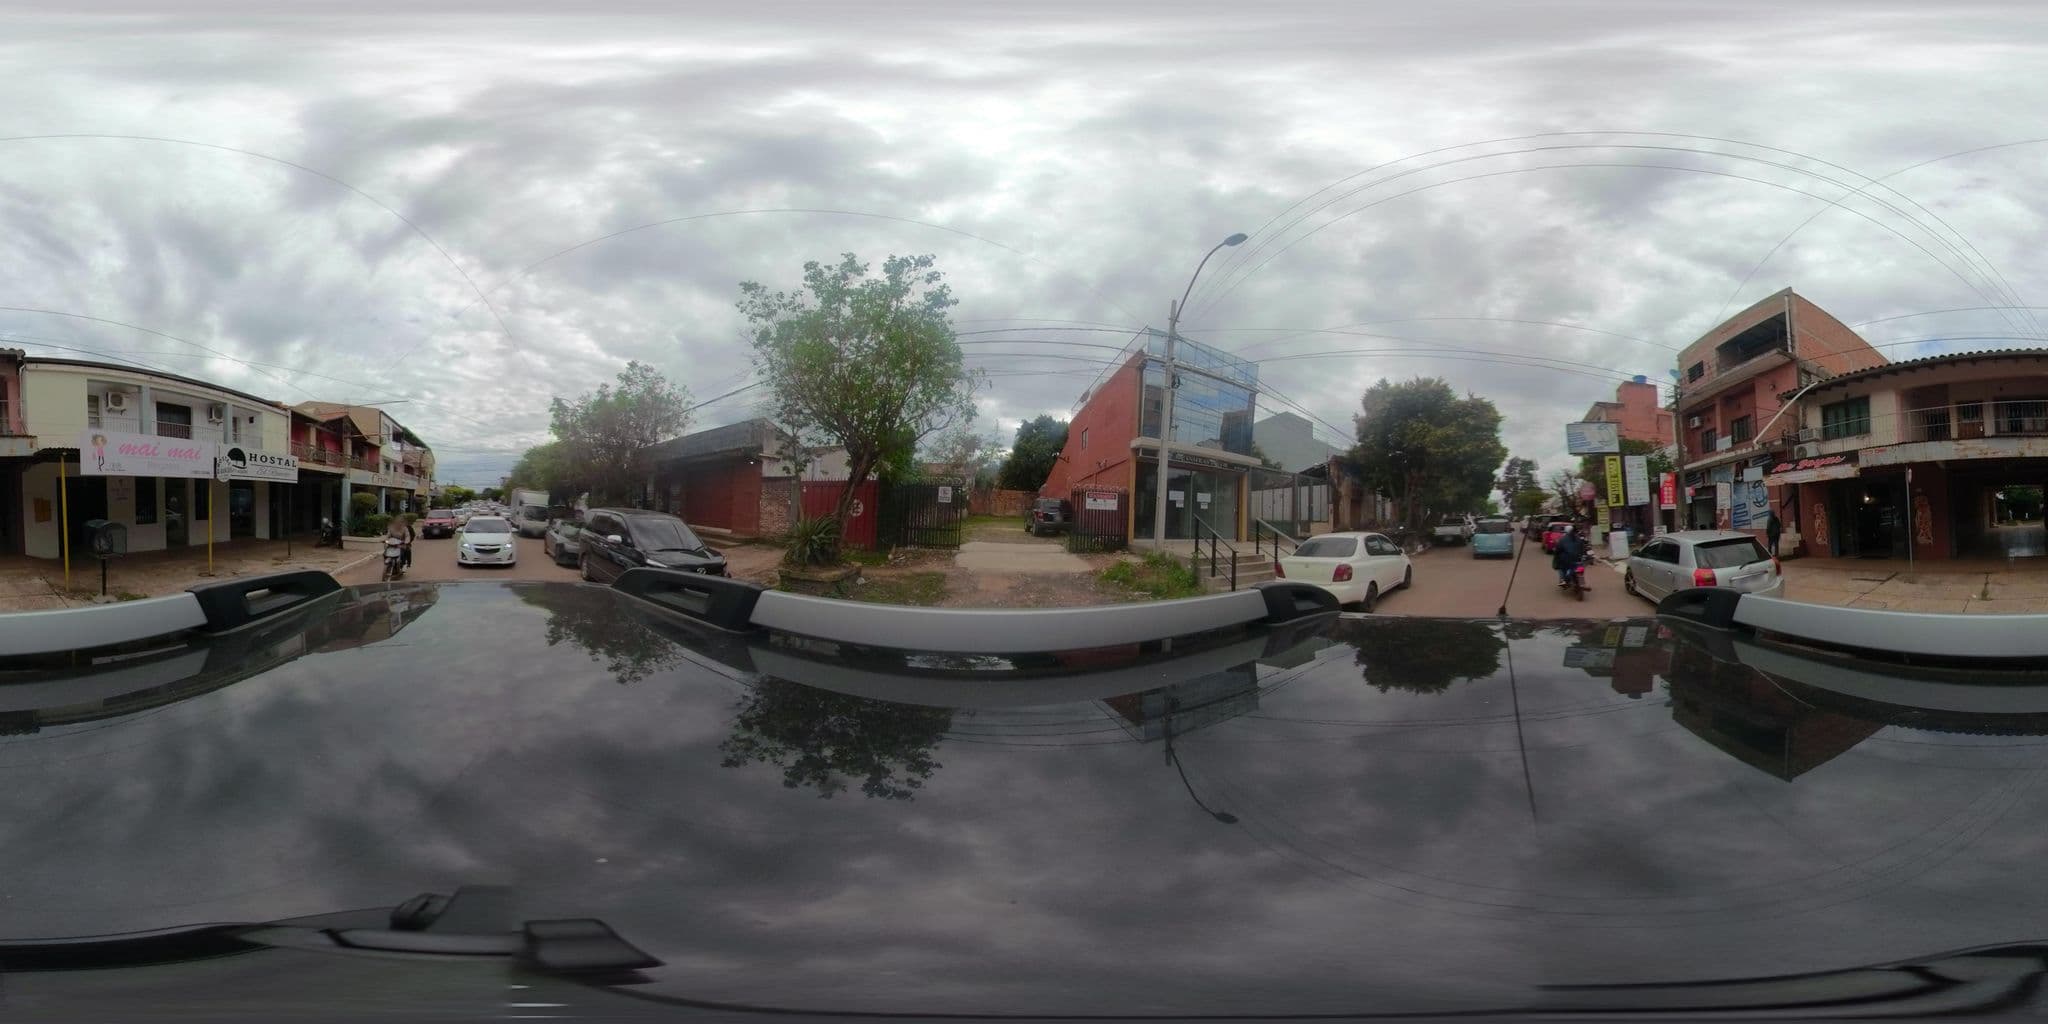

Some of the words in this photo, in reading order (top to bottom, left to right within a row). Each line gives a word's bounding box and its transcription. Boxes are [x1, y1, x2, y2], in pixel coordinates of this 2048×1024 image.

[119, 442, 160, 457] mai
[167, 447, 202, 460] mai
[249, 453, 297, 468] HOSTAL
